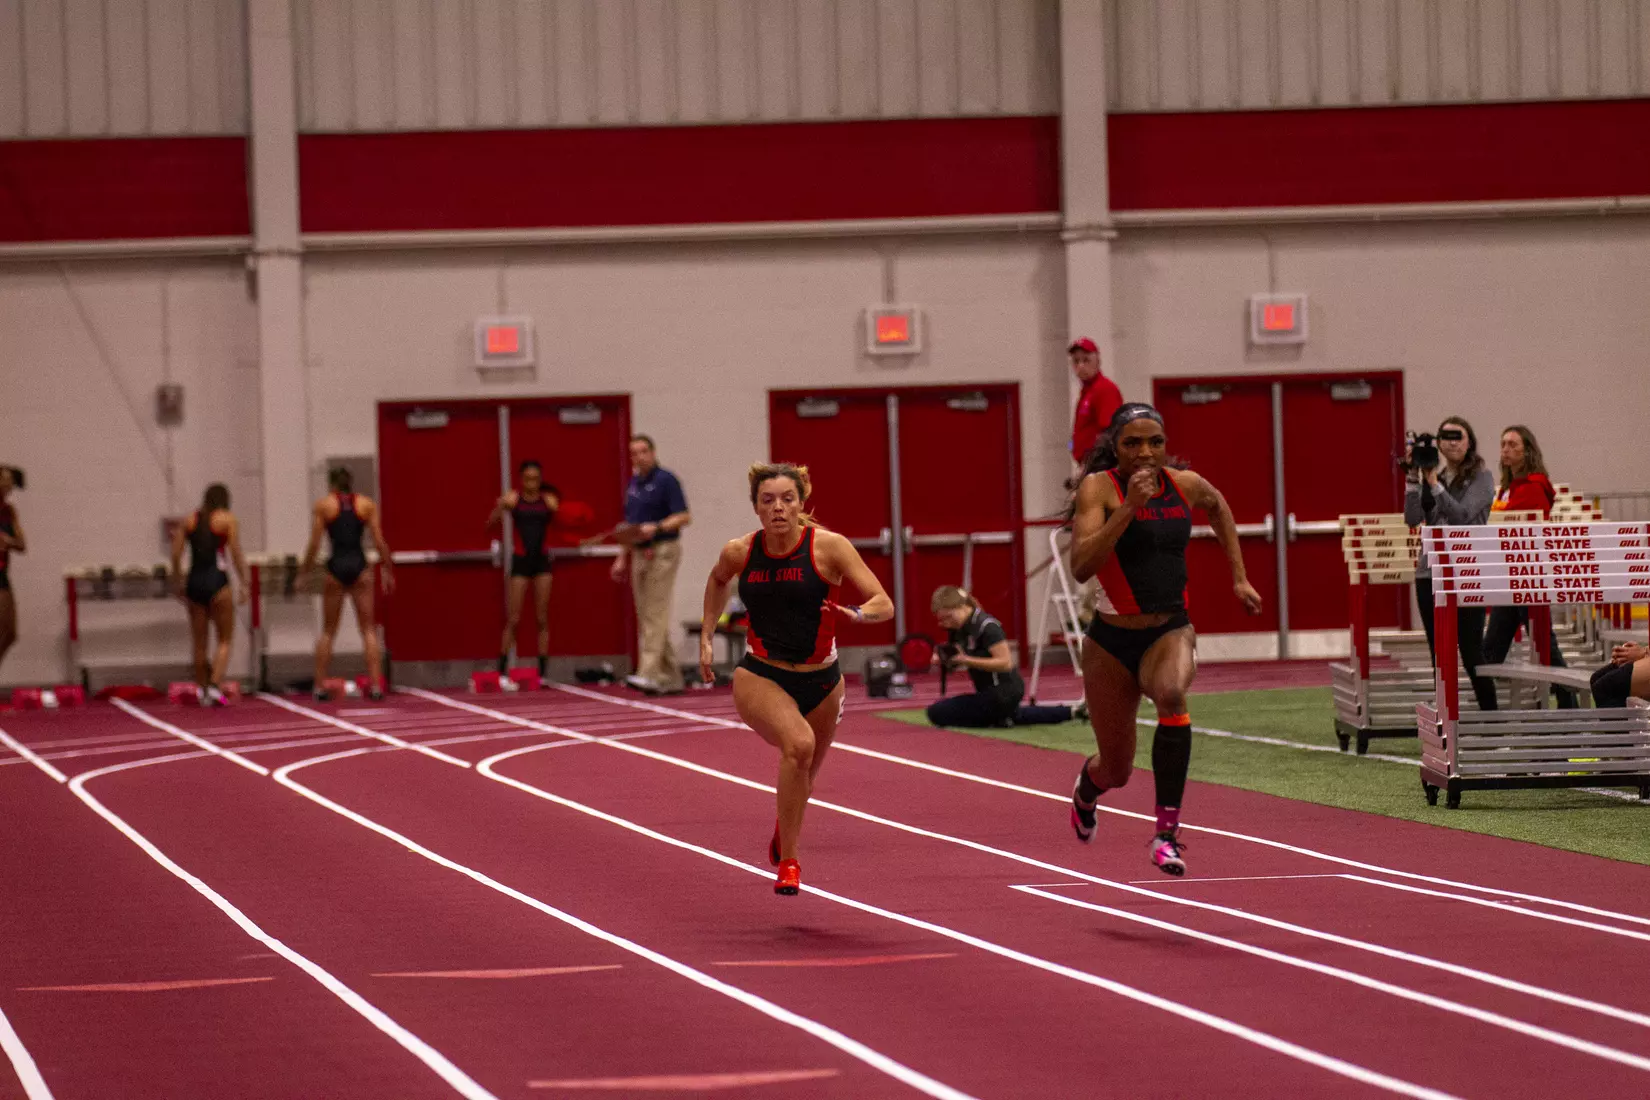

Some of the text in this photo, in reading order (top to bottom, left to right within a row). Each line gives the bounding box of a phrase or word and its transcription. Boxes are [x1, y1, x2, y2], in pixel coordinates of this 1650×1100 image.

[1498, 526, 1589, 538] BALL STATE
[1617, 527, 1639, 535] GILL
[1451, 543, 1472, 551] GILL
[1500, 539, 1591, 550] BALL STATE
[1456, 556, 1477, 564] GILL
[1505, 552, 1595, 563] BALL STATE
[1509, 564, 1600, 576] BALL STATE
[1628, 565, 1649, 573] GILL
[747, 567, 805, 583] BALL STATE
[1460, 582, 1481, 590] GILL
[1510, 577, 1601, 589] BALL STATE
[1629, 578, 1650, 586] GILL
[1463, 595, 1484, 603] GILL
[1513, 590, 1604, 603] BALL STATE
